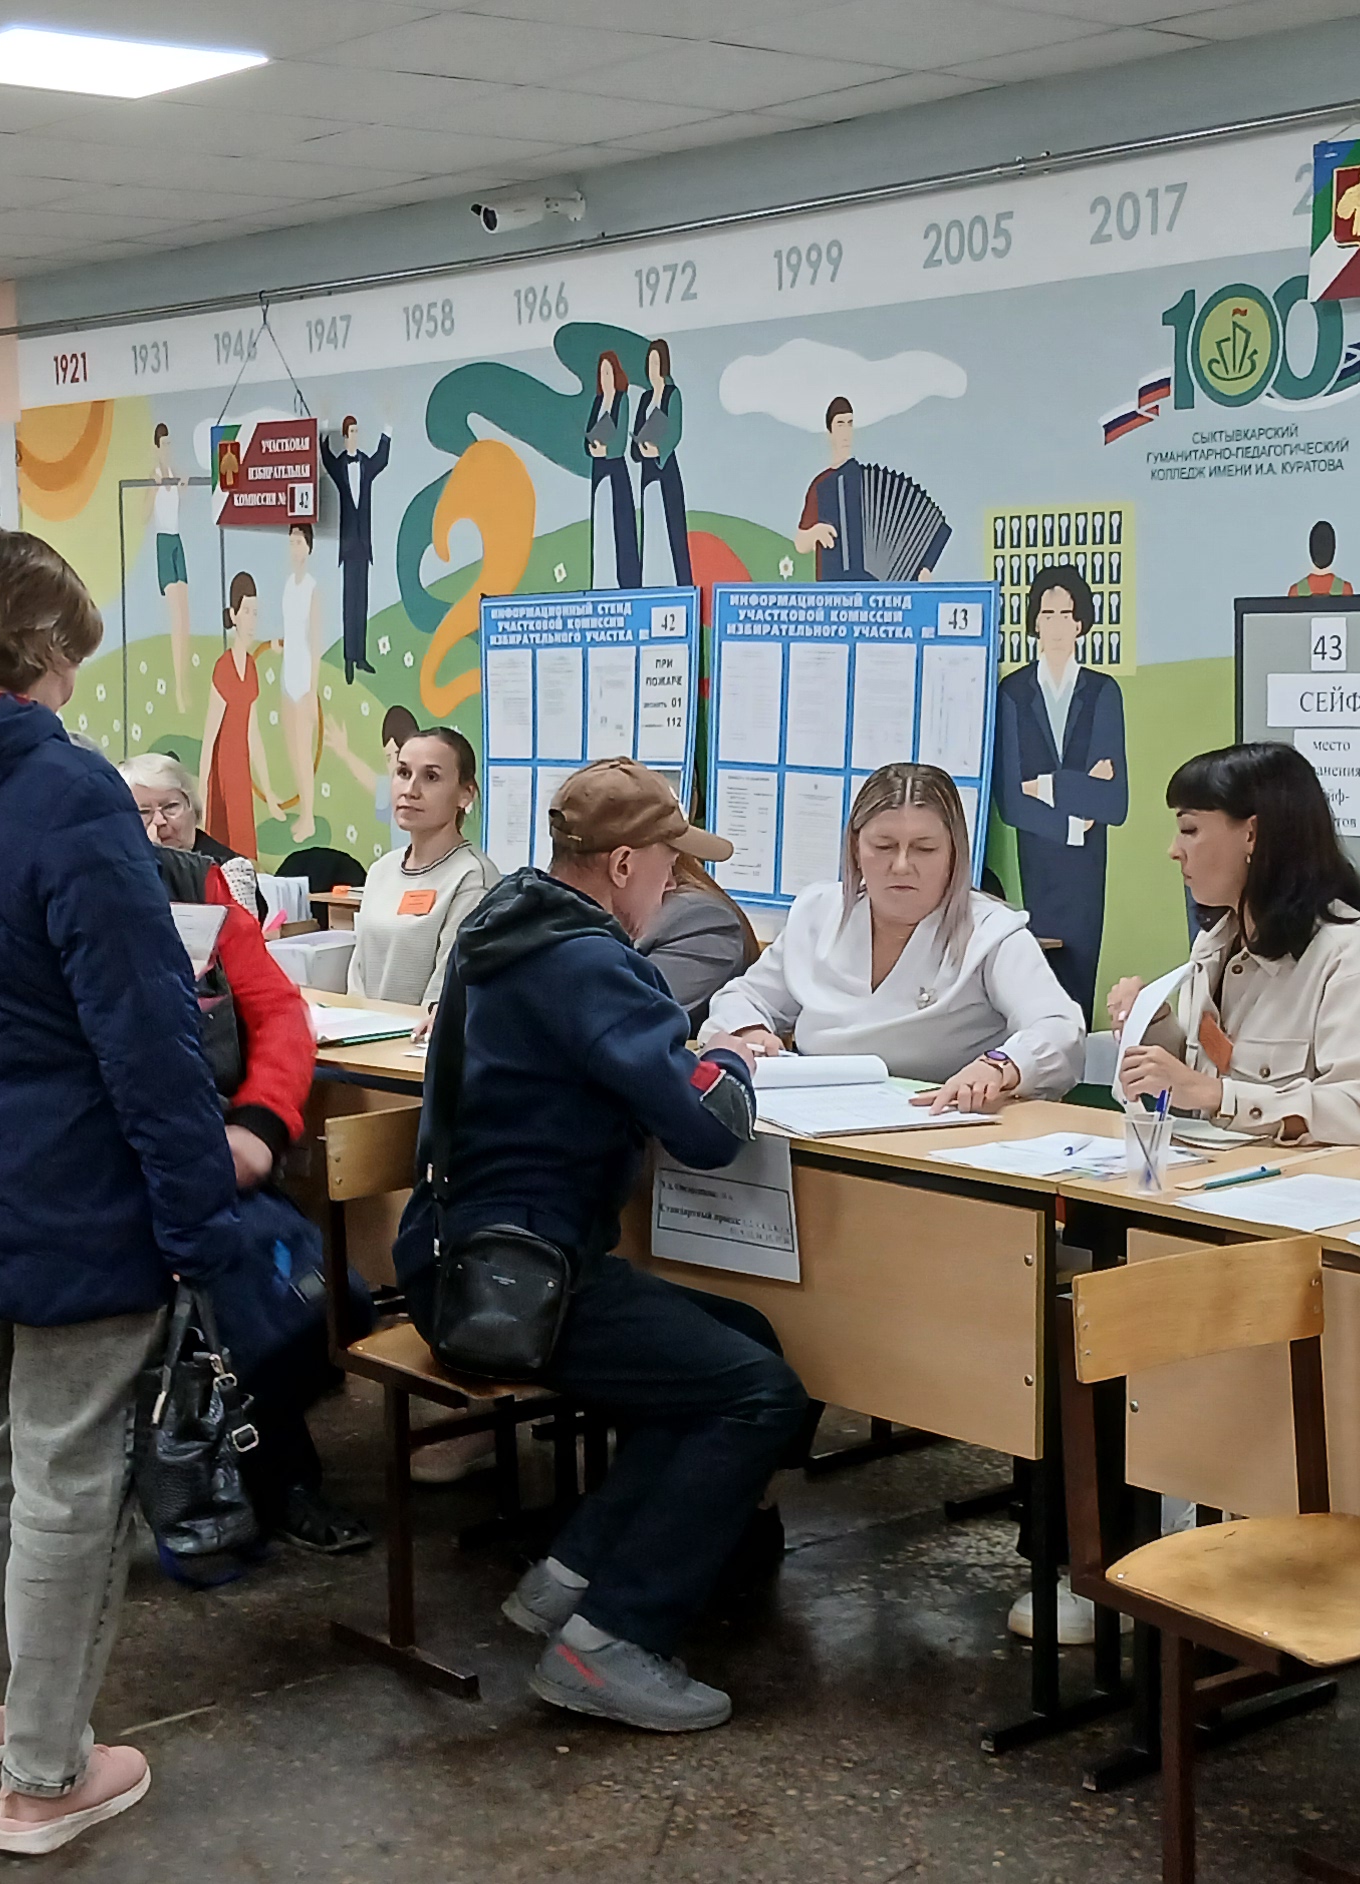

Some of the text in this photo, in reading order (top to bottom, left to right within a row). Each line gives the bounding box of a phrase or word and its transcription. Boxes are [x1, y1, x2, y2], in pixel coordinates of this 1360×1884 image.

[1090, 182, 1188, 245] 2017
[923, 211, 1013, 269] 2005
[773, 240, 843, 291] 1999
[634, 260, 698, 308] 1972
[513, 281, 569, 326] 1966
[403, 298, 455, 341] 1958
[306, 314, 352, 354] 1947
[1162, 274, 1344, 410] 100
[53, 352, 88, 385] 1921
[132, 340, 169, 375] 1931
[261, 437, 310, 454] УЧАСТКОВАЯ
[1192, 423, 1299, 445] СЫКТЫВКАРСКИЙ
[1146, 440, 1350, 464] ГУМАНИТАРНО-ПЕДАГОГИЧЕСКИЙ
[248, 464, 310, 480] ИЗБИРАТЕЛЬНАЯ
[1150, 458, 1344, 482] КОЛЛЕДЖ ИМЕНИ И.А. КУРАТОВА
[234, 492, 276, 507] КОМИССИЯ
[490, 602, 632, 620] ИНФОРМАЦИОННЫЙ СТЕНД
[730, 592, 912, 609] ИНФОРМАЦИОННЫЙ СТЕНД
[498, 616, 625, 633] УЧАСТКОВОЙ КОМИССИИ
[726, 624, 847, 638] ИЗБИРАТЕЛЬНОГО
[853, 625, 914, 638] УЧАСТКА
[948, 608, 969, 630] 43
[738, 607, 903, 624] УЧАСТКОВОЙ КОМИССИИ
[490, 630, 582, 646] ИЗБИРАТЕЛЬНОГО
[586, 629, 633, 642] УЧАСТКА
[661, 614, 676, 632] 42
[1314, 635, 1342, 661] 43
[655, 658, 674, 669] ПРИ
[646, 676, 683, 686] ПОЖАРЕ
[671, 697, 682, 708] 01
[666, 717, 682, 728] 112
[1313, 742, 1351, 751] место
